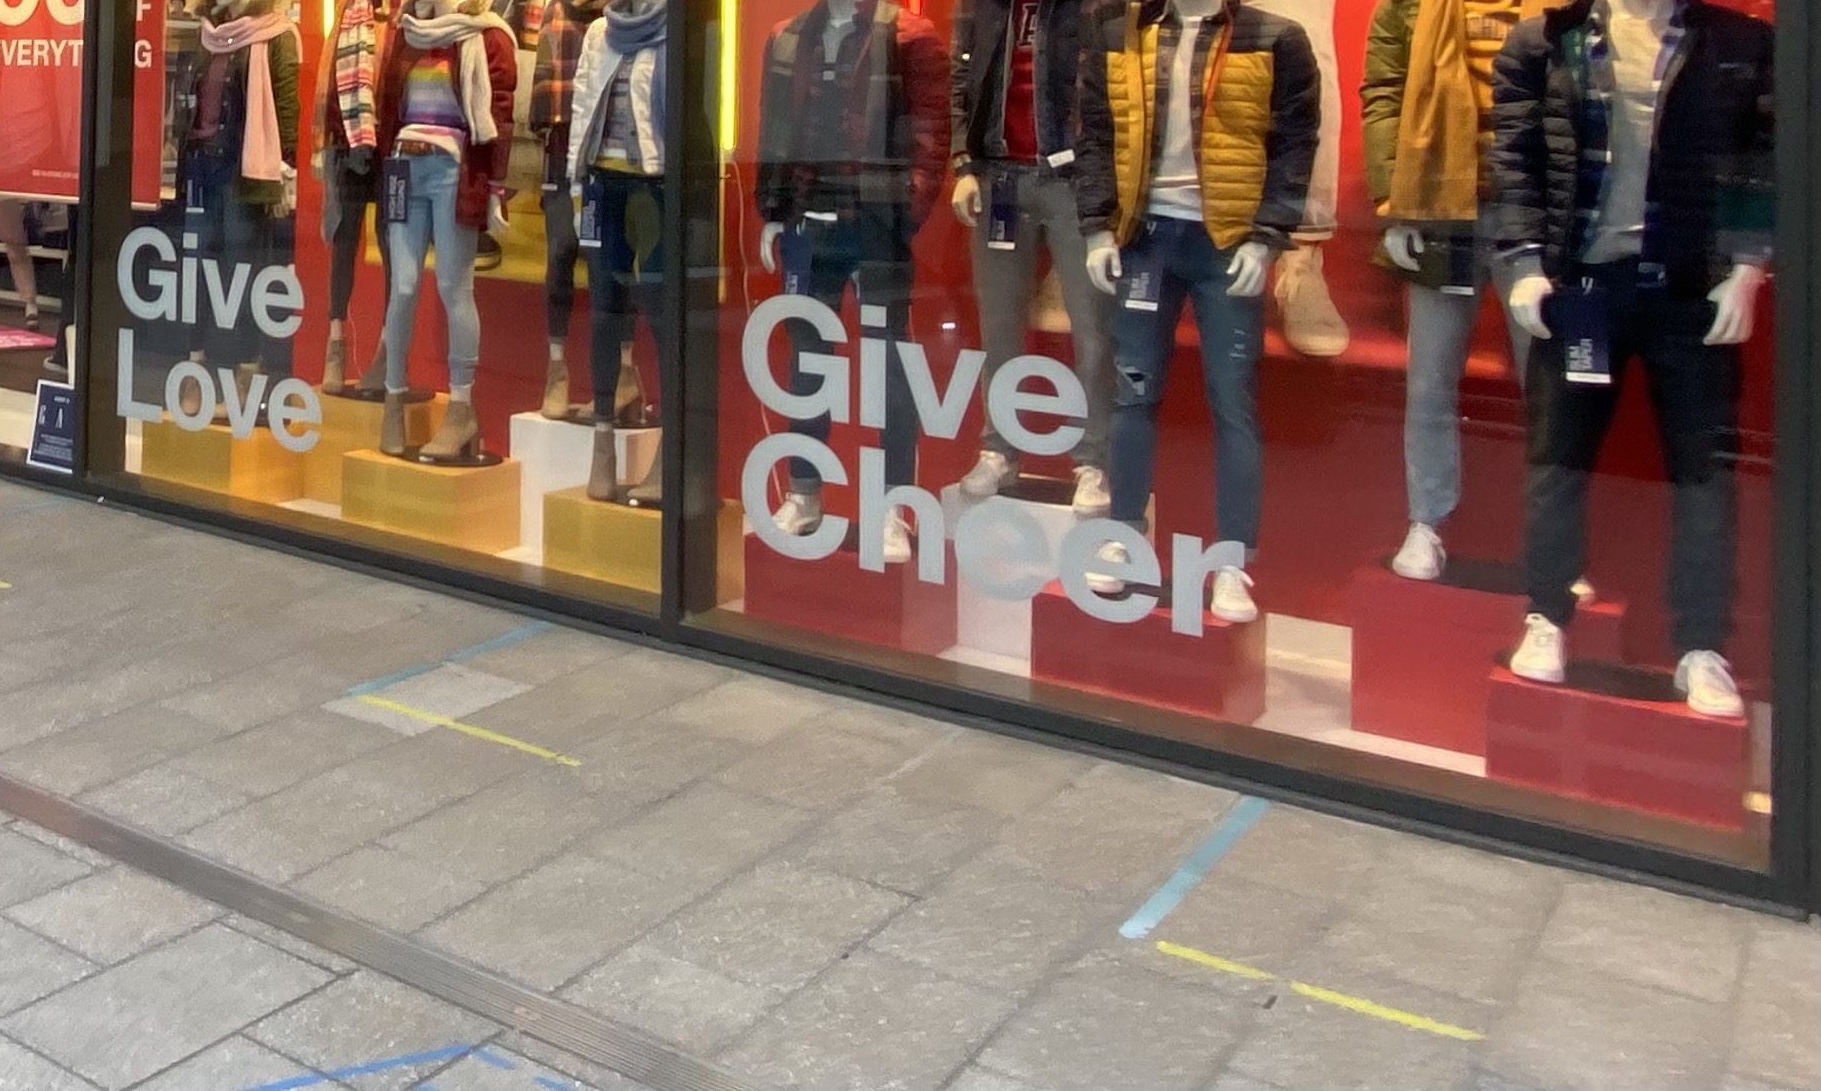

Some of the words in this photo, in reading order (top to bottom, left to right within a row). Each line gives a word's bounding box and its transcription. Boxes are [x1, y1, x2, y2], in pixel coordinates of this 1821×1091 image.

[117, 226, 304, 338] Give
[117, 327, 322, 452] Love
[742, 293, 1088, 456] Give
[741, 432, 1245, 637] Cheer
